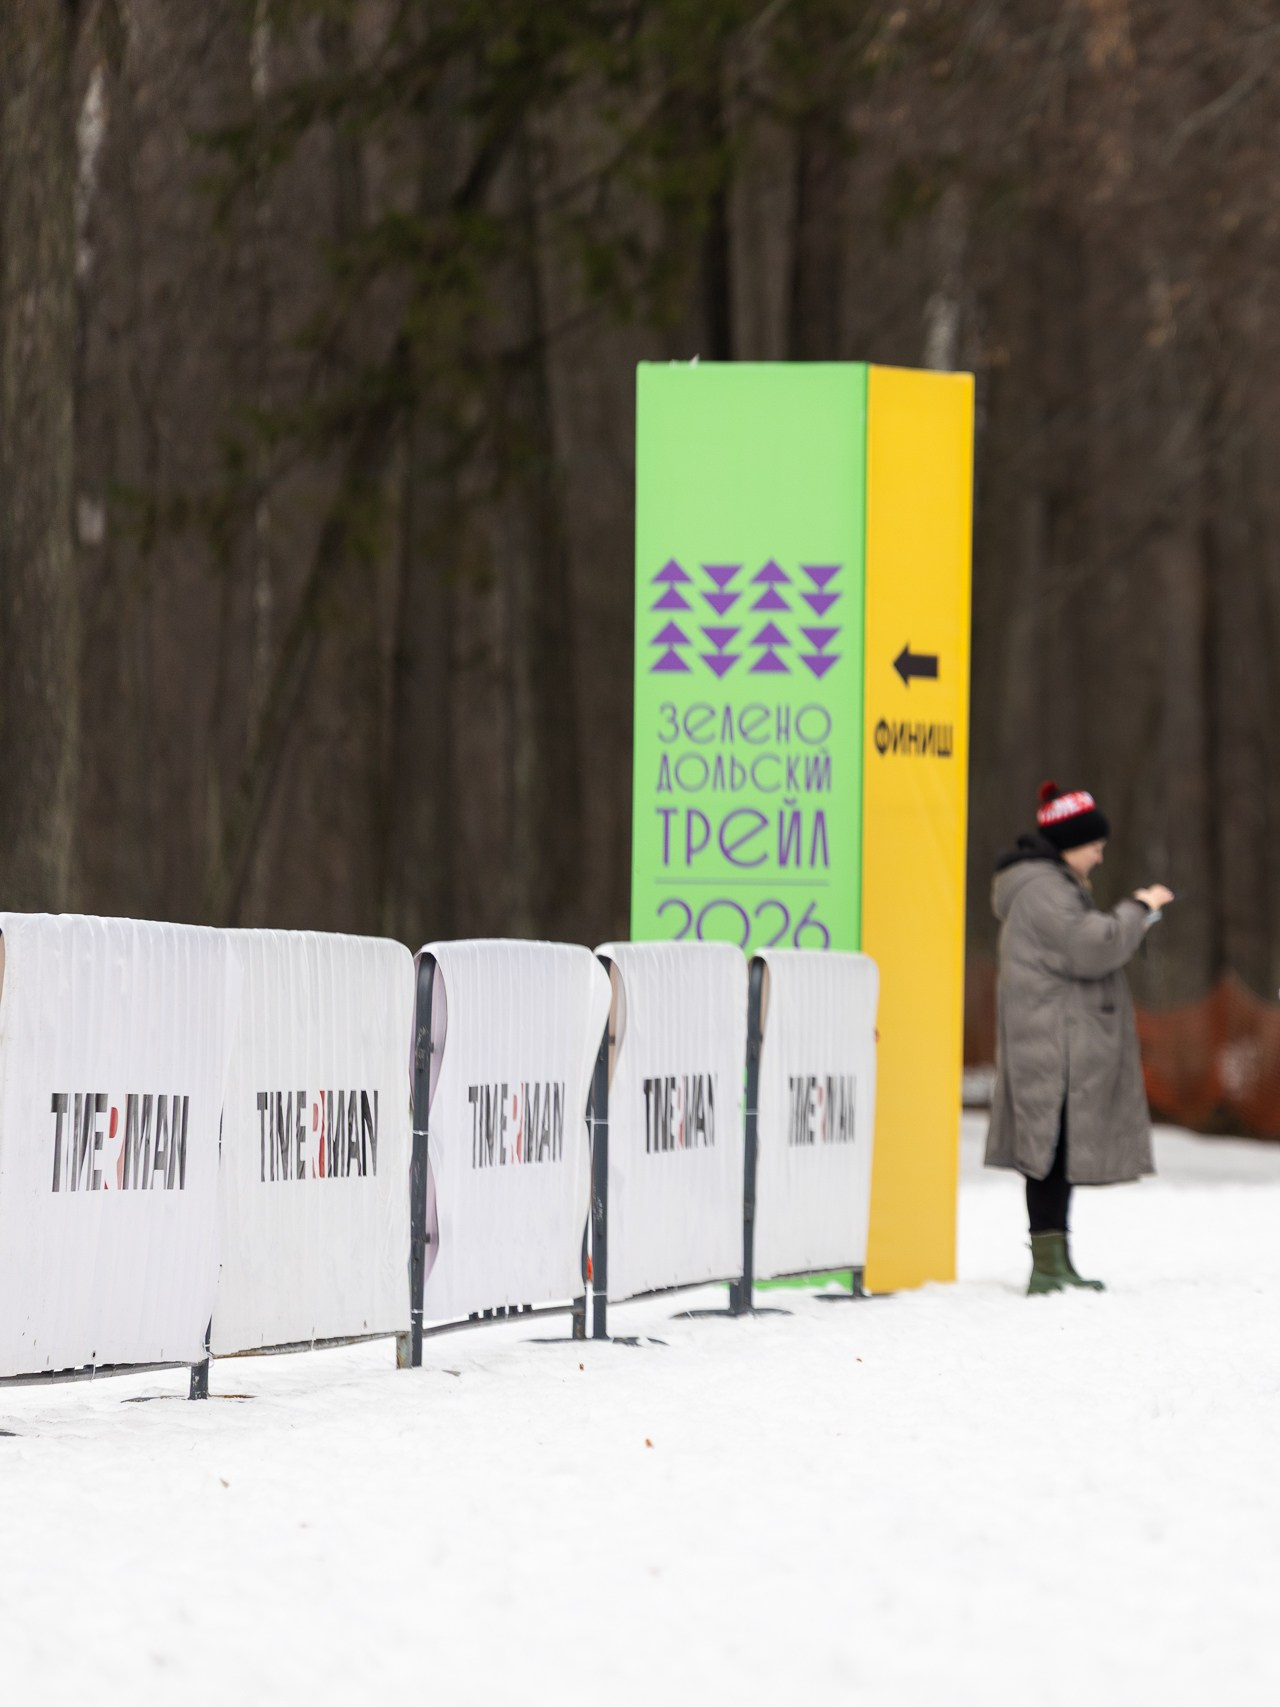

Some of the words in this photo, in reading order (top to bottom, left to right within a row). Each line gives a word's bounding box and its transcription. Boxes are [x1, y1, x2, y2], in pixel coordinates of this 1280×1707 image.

[874, 718, 954, 757] ФИНИШ
[656, 898, 831, 949] 2026
[51, 1093, 189, 1192] TIMERMAN
[257, 1090, 379, 1182] TIMERMAN
[468, 1082, 565, 1169] TIMERMAN
